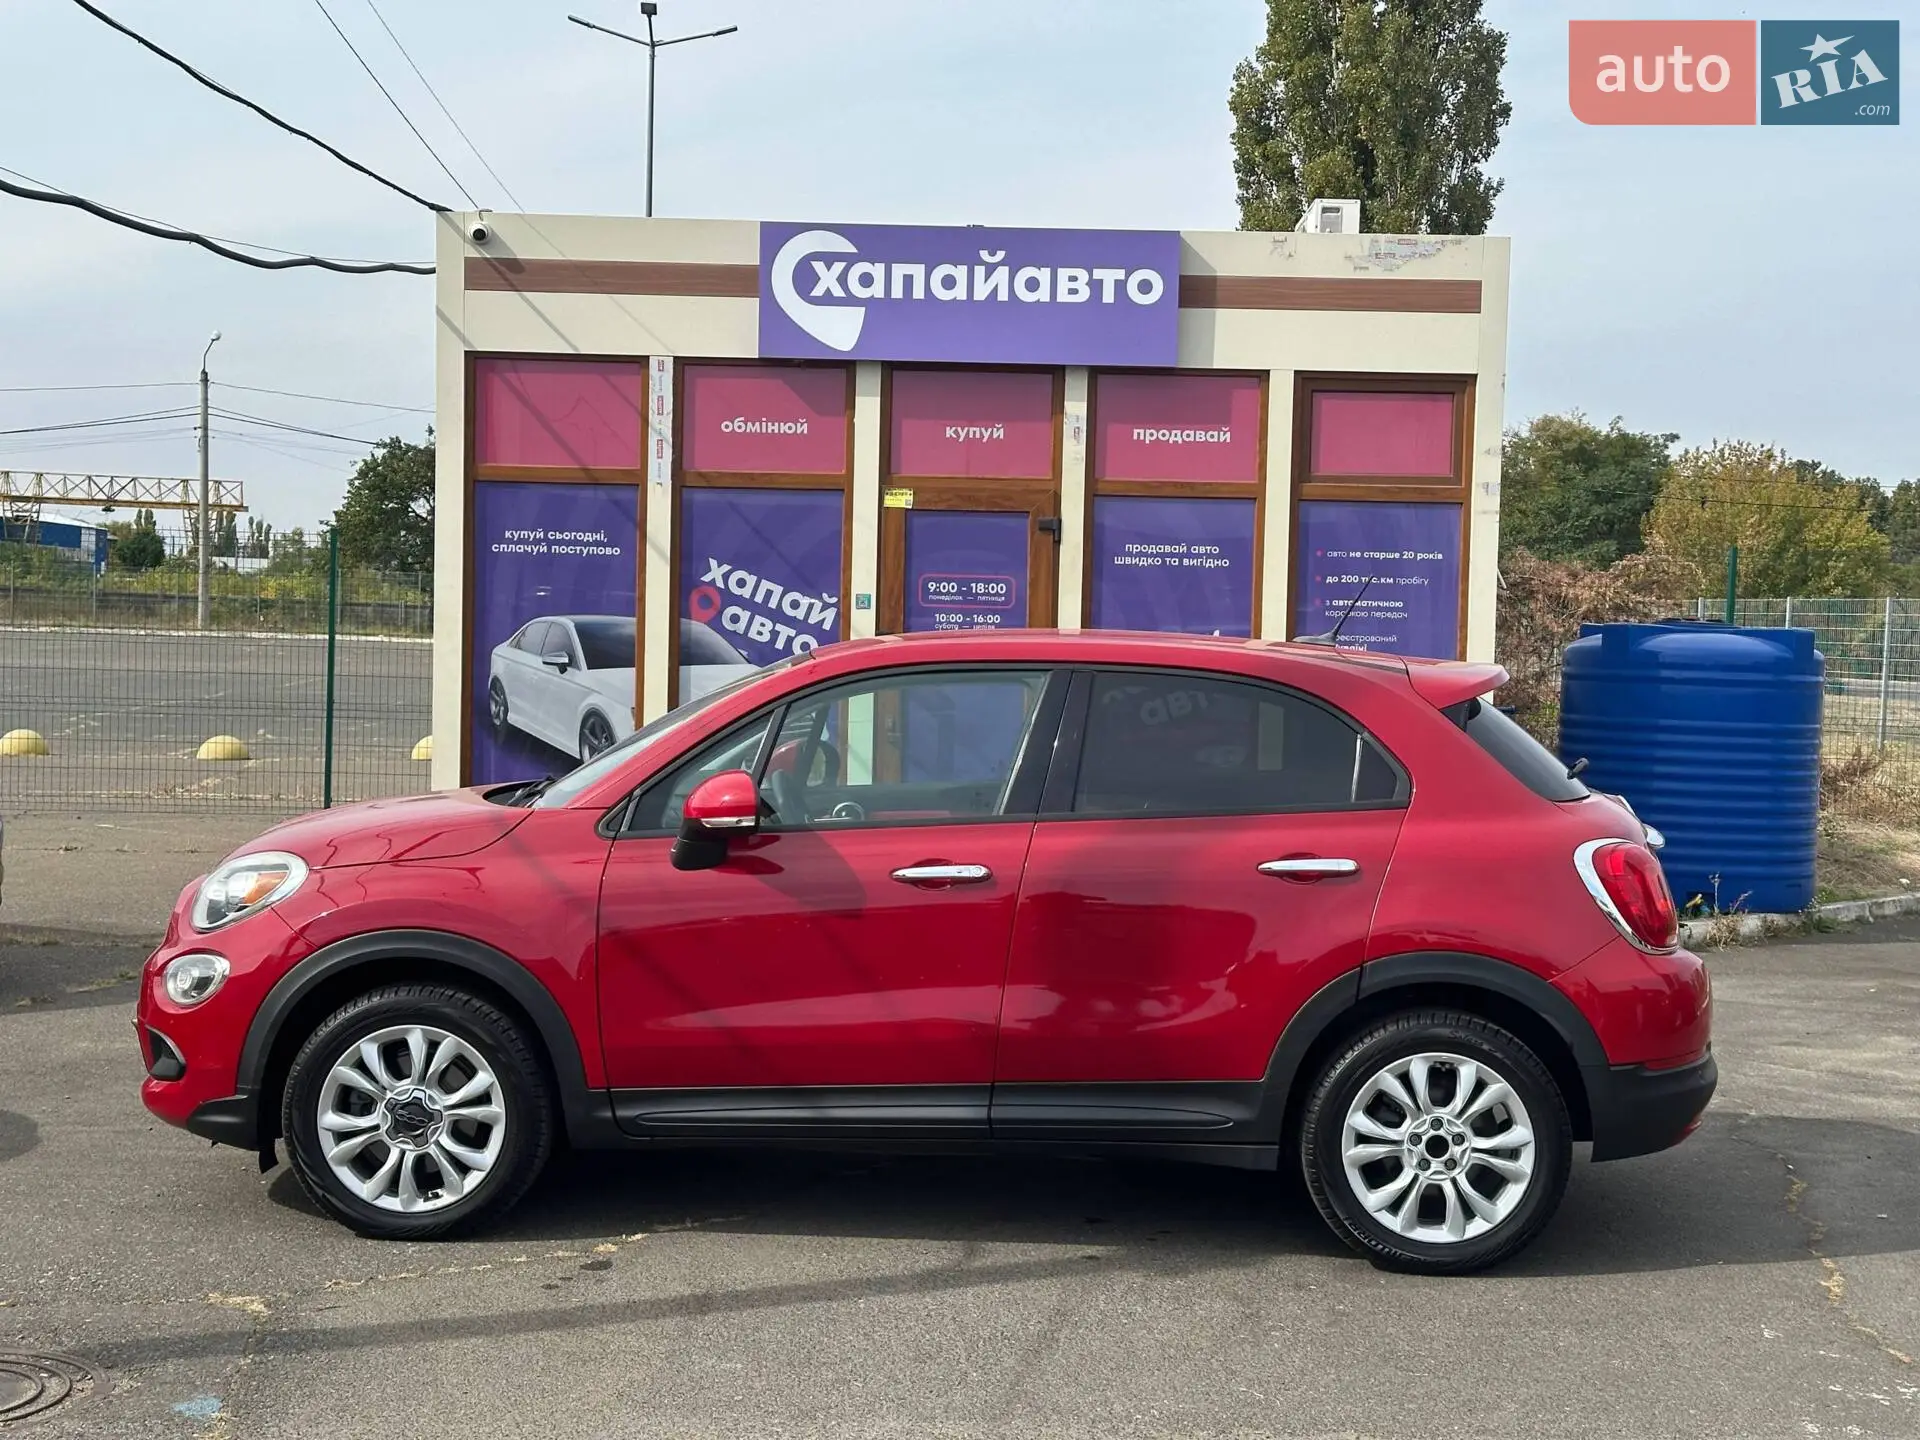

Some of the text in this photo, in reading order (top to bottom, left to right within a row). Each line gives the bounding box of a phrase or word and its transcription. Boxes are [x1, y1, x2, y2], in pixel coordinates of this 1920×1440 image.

[809, 250, 1165, 305] хапайавто
[720, 416, 808, 434] обмінюй
[945, 423, 1004, 443] купуй
[1133, 427, 1231, 444] продавай
[504, 528, 608, 543] купуй сьогодні,
[491, 542, 621, 557] сплачуй поступово
[1125, 543, 1220, 555] продавай авто
[1363, 551, 1401, 560] старше
[1402, 551, 1415, 559] 20
[1416, 551, 1443, 560] років
[1114, 556, 1230, 568] швидко та вигідно
[928, 582, 957, 593] 9:00
[970, 583, 1006, 594] 18:00
[1325, 575, 1339, 584] до
[1340, 575, 1359, 583] 200
[1395, 577, 1429, 586] пробігу
[700, 557, 838, 631] хапай
[935, 613, 963, 622] 10:00
[972, 614, 1000, 623] 16:00
[1325, 610, 1369, 619] корокою
[721, 605, 818, 655] авто
